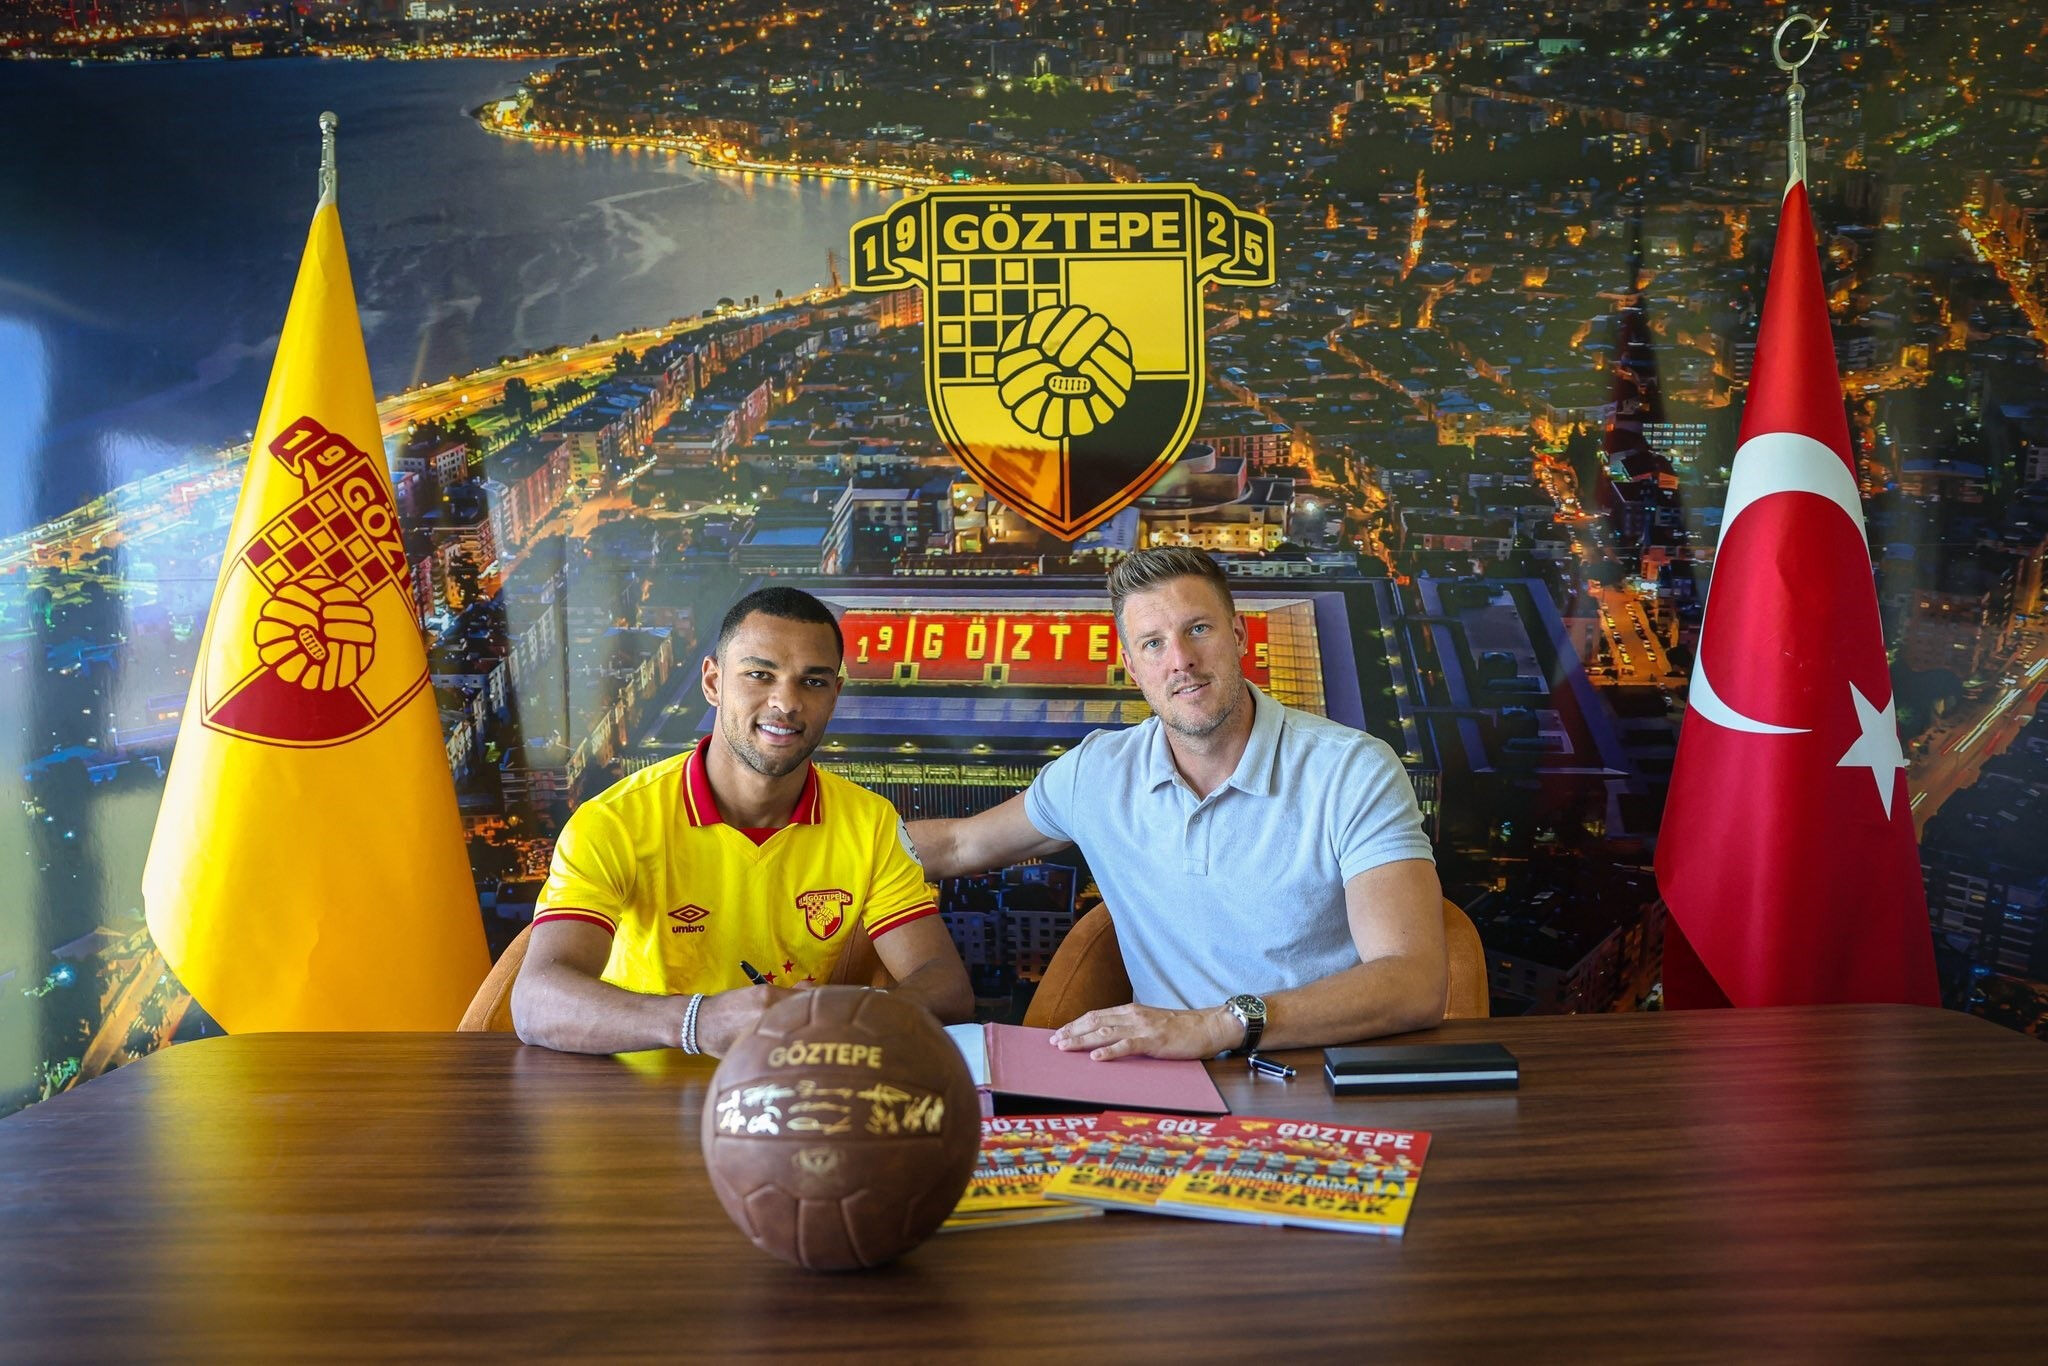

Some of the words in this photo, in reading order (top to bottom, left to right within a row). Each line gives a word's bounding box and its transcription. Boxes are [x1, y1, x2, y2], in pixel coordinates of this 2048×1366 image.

[943, 203, 1180, 252] GÖZTEPE
[342, 476, 407, 578] GÖZ
[922, 616, 1110, 661] GÖZTE
[672, 924, 705, 934] umbro
[768, 1040, 882, 1068] GÖZTEPE
[1157, 1118, 1217, 1135] GÖZ
[1277, 1122, 1414, 1150] GÖZTEPE
